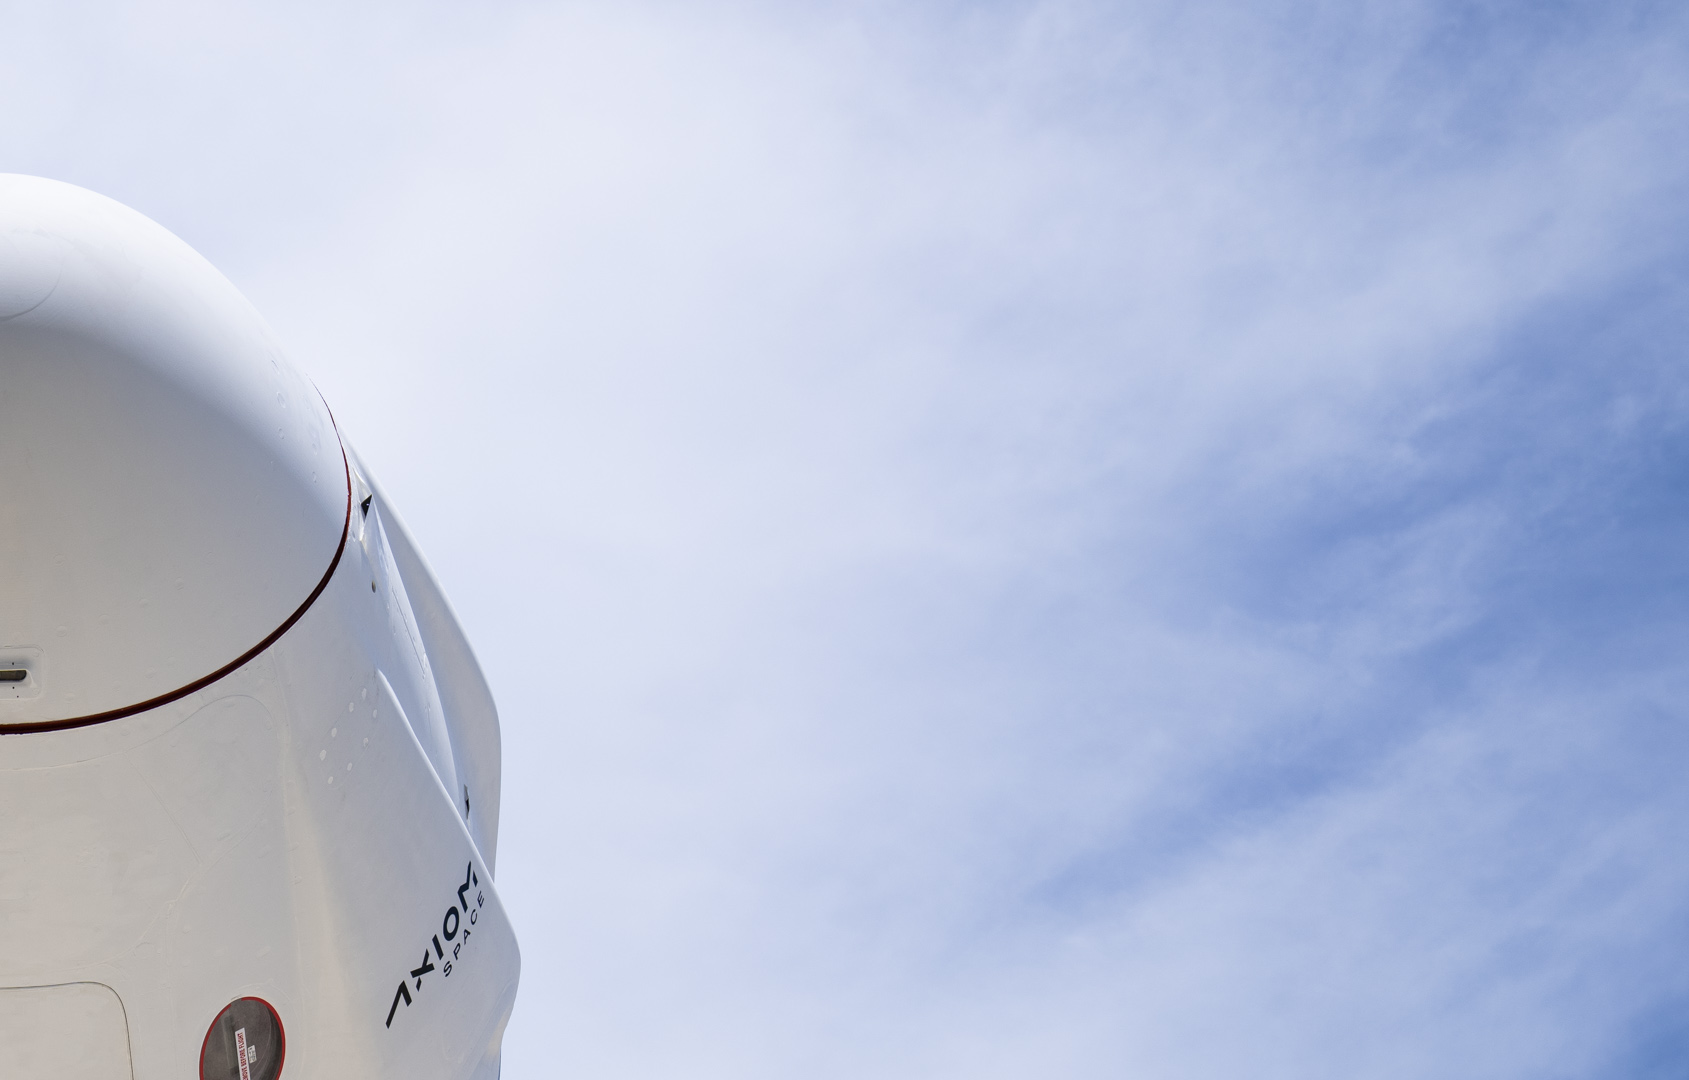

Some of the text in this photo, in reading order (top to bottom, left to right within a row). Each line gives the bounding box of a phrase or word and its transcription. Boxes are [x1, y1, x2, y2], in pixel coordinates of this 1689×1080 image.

[385, 860, 479, 1029] AXIOM
[443, 890, 485, 977] SPACE
[239, 1049, 247, 1067] BEFORE
